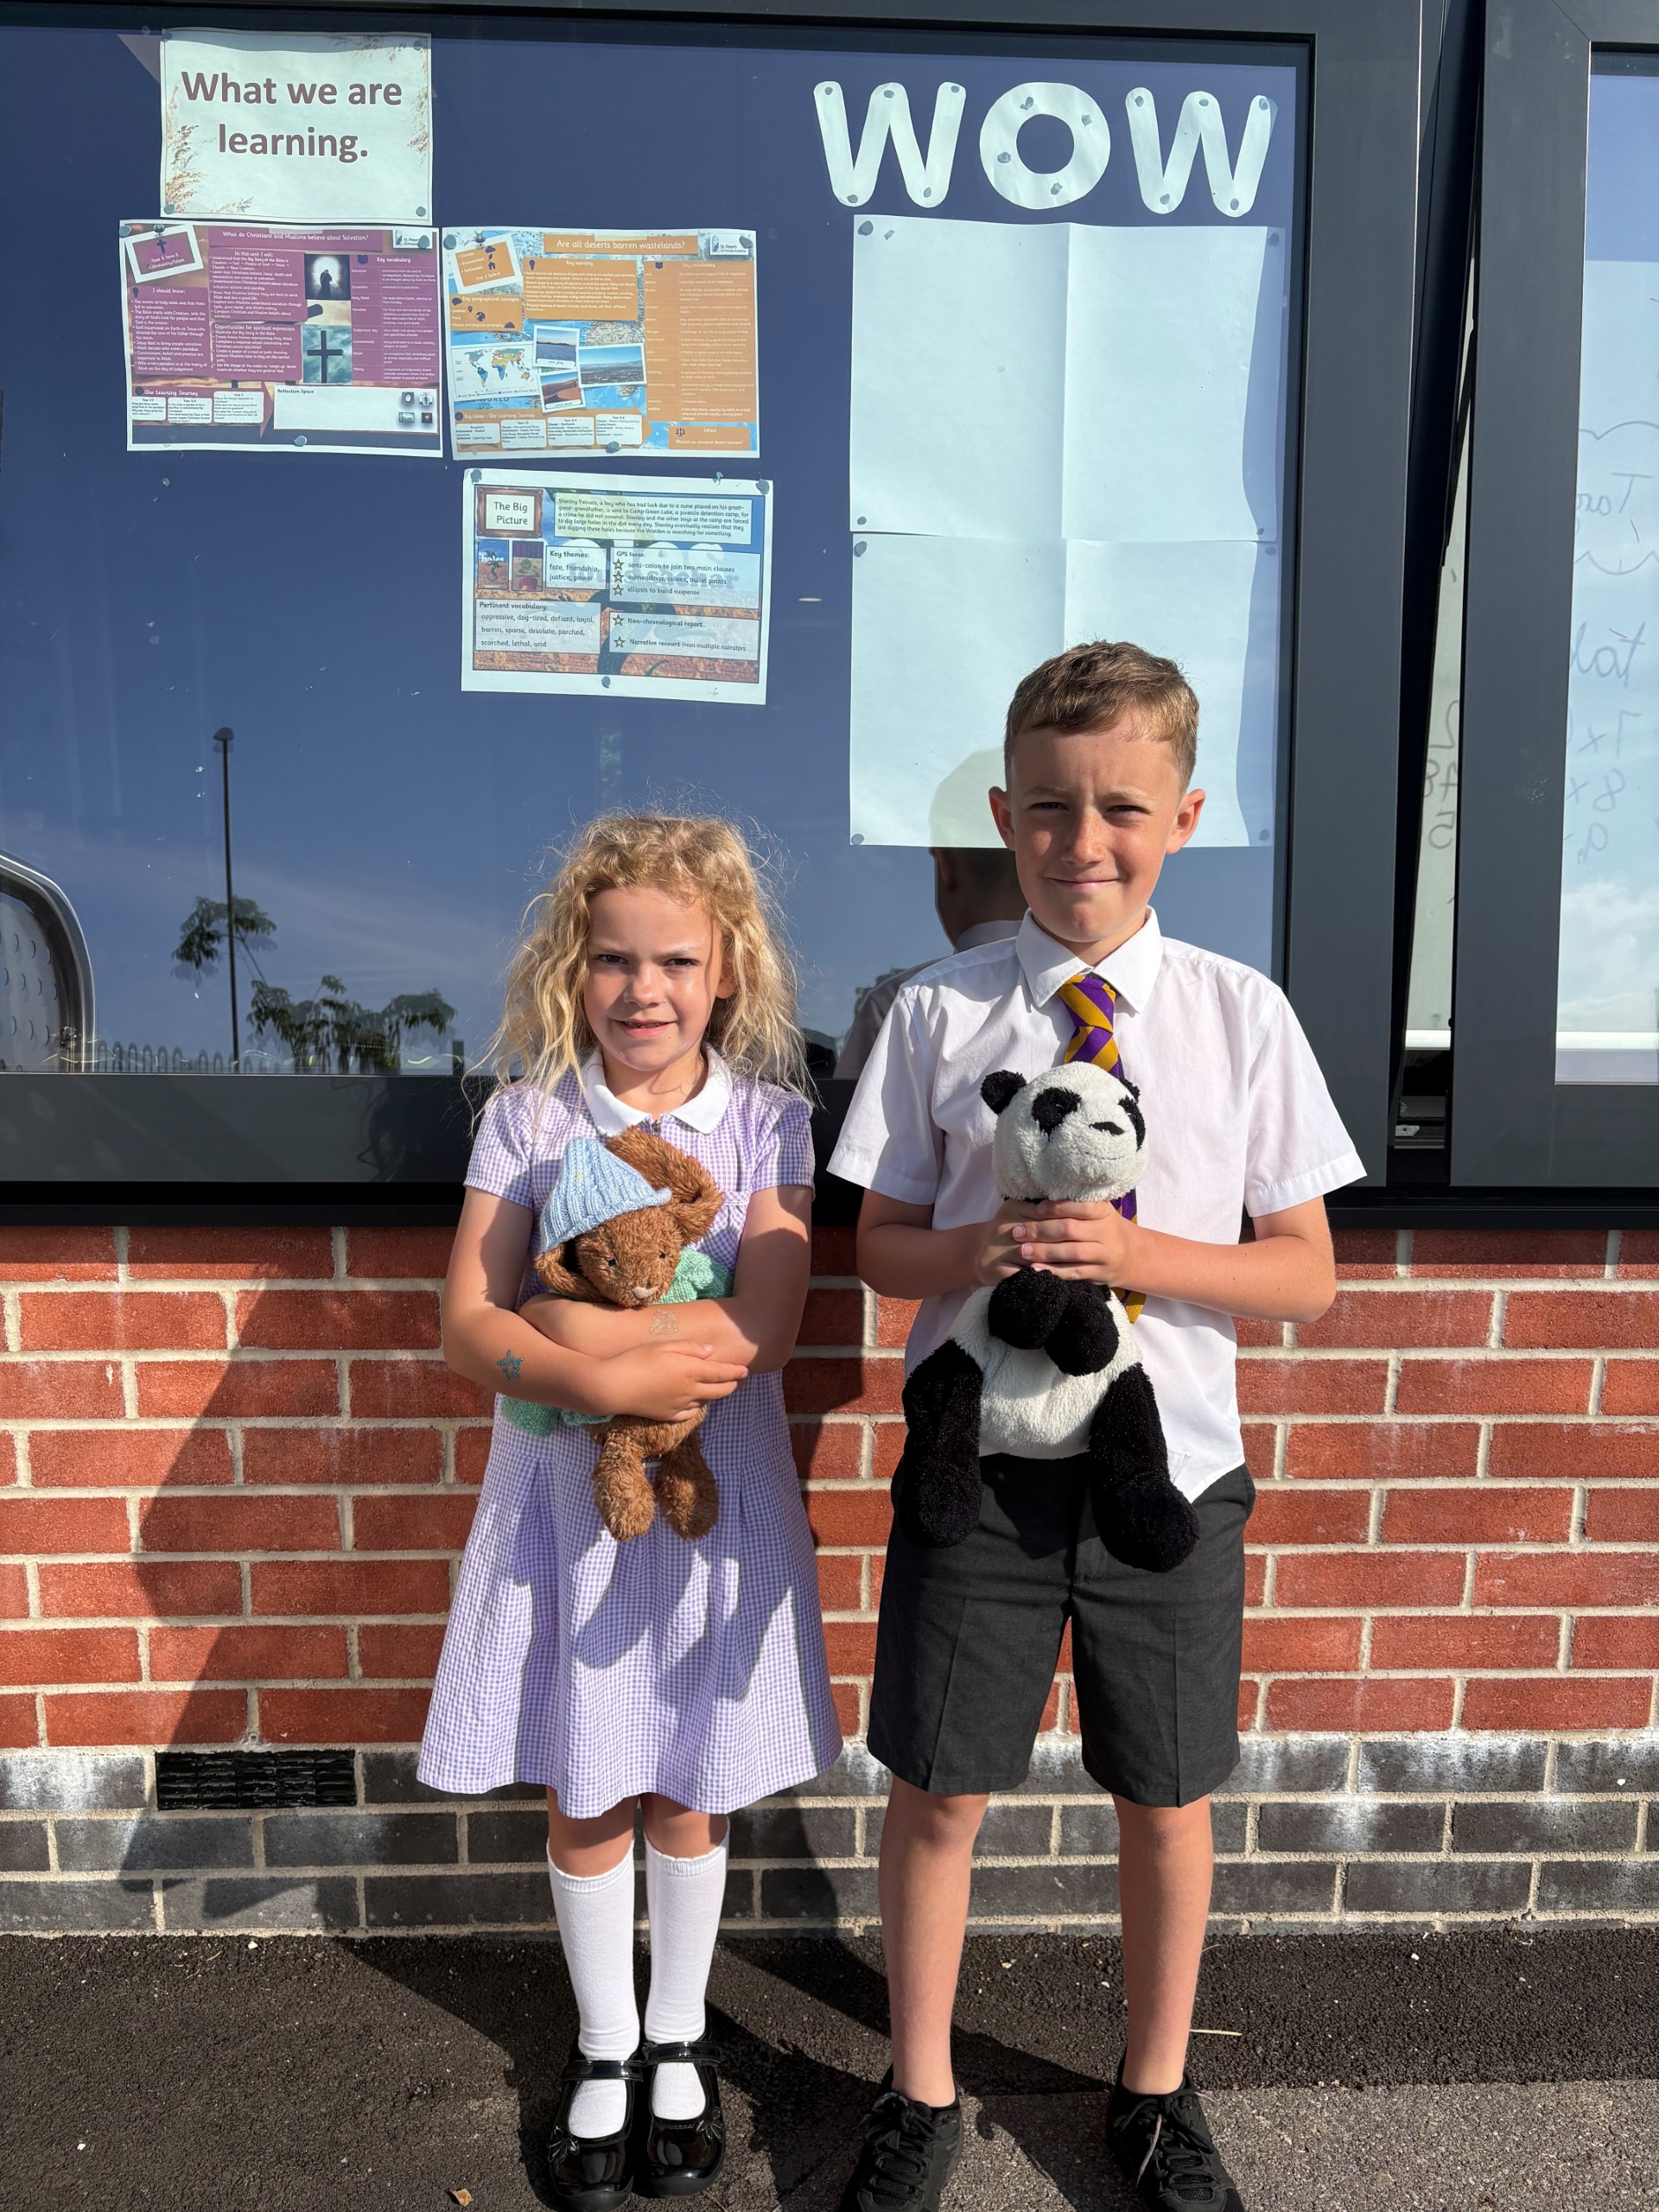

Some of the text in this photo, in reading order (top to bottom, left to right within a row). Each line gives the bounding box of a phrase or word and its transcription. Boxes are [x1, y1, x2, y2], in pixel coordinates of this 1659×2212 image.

[181, 71, 403, 105] What we are
[219, 124, 368, 163] learning.
[814, 81, 1276, 217] WOW
[494, 502, 528, 513] The Big
[496, 515, 528, 525] Picture
[550, 551, 562, 559] Key
[549, 564, 600, 573] fate, friendship,
[549, 574, 572, 582] justice,
[628, 575, 666, 583] subheadings,
[510, 603, 548, 612] vocabulary:
[481, 613, 594, 624] oppressive, dog-tired, defiant, loyal,
[628, 618, 703, 629] Non-chronological report
[481, 626, 503, 634] barren,
[527, 627, 556, 636] desolate,
[557, 628, 585, 637] parched,
[481, 639, 510, 648] scorched,
[511, 640, 532, 648] lethal,
[696, 642, 719, 651] multiple
